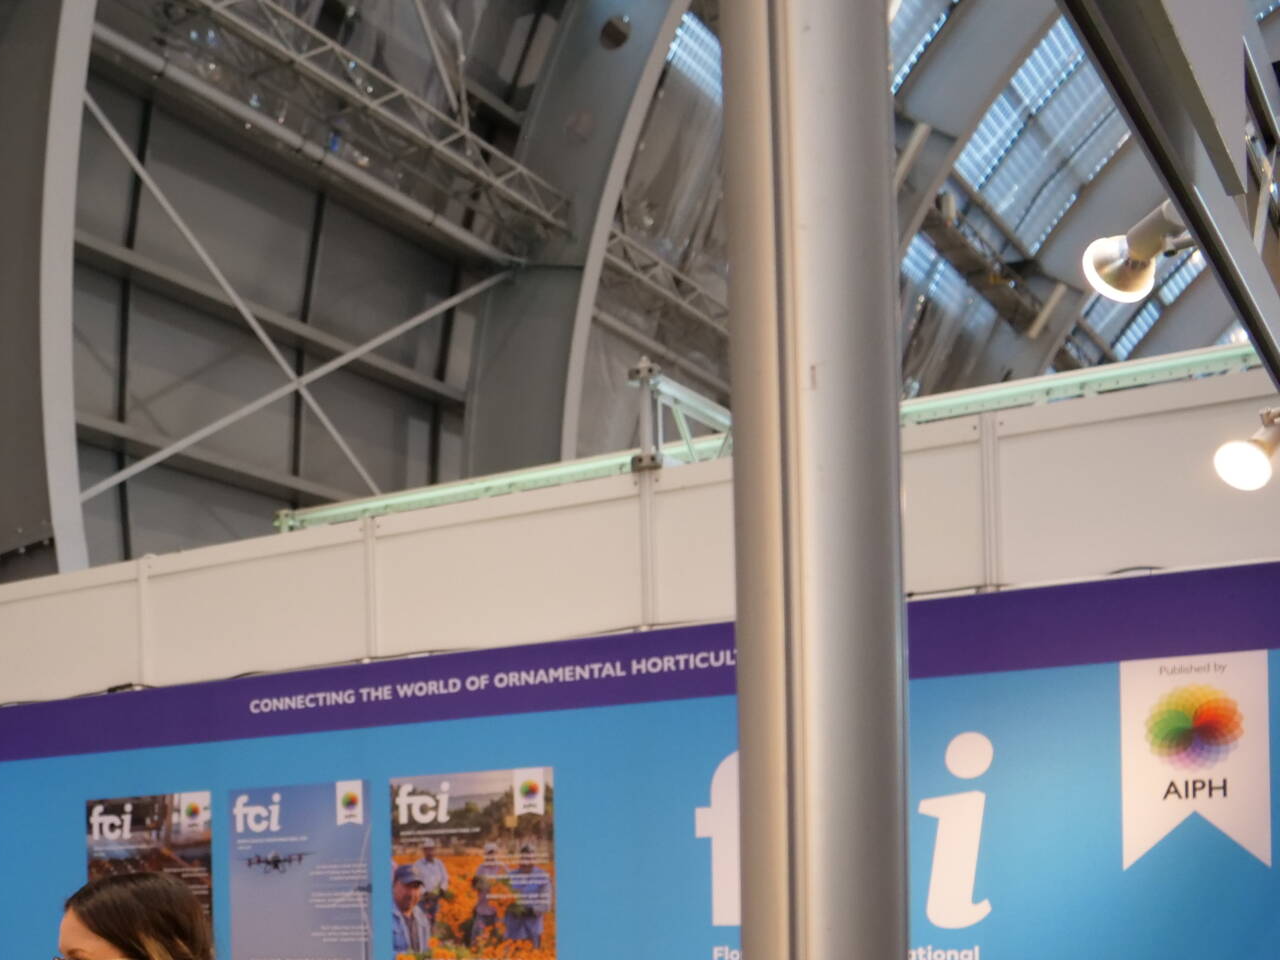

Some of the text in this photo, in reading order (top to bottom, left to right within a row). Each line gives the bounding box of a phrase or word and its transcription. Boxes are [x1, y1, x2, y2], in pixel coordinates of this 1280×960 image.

[249, 648, 738, 715] CONNECTING THE WORLD OF ORNAMENTAL HORTICUL
[1159, 661, 1228, 676] Published by
[394, 782, 451, 825] fci
[1163, 778, 1228, 801] AIPH
[89, 802, 133, 842] fci
[232, 792, 282, 834] fci
